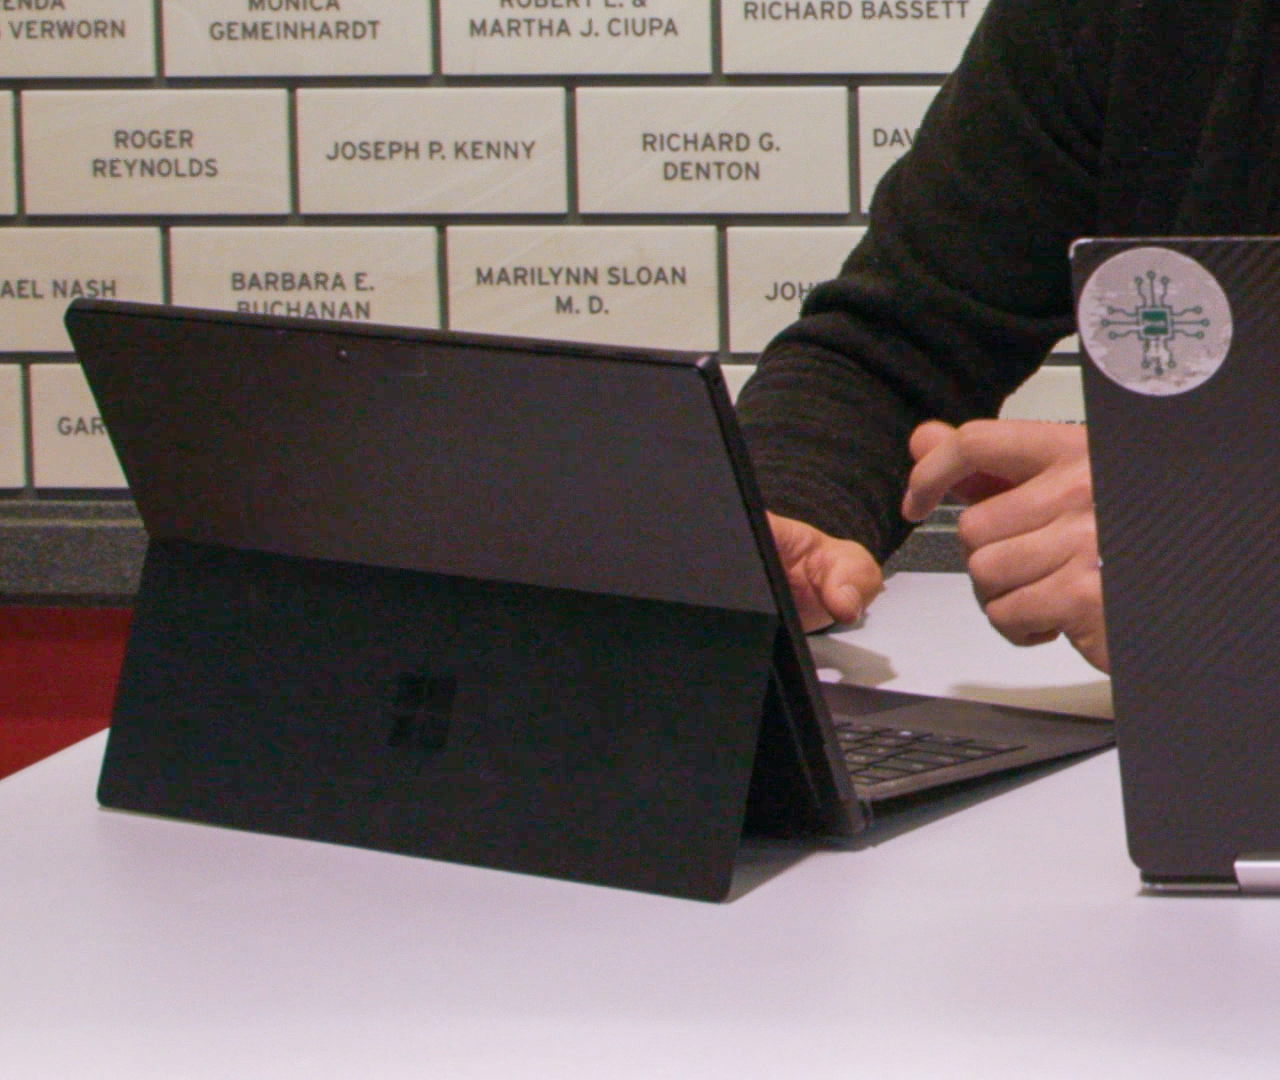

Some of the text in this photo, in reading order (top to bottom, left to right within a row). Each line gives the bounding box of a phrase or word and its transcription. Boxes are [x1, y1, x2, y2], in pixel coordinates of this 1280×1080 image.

[743, 0, 970, 21] RICHARD BASSETT
[7, 19, 126, 40] VERWORN
[208, 19, 380, 41] GEMEINHARDT
[469, 17, 679, 38] MARTHA CIUPA
[113, 129, 194, 150] ROGER
[641, 132, 751, 153] RICHARD
[325, 140, 536, 162] JOSEPH KENNY
[91, 157, 219, 179] REYNOLDS
[663, 160, 761, 182] DENTON
[230, 271, 347, 292] BARBARA
[475, 265, 687, 287] MARILYNN SLOAN
[52, 279, 117, 300] NASH
[555, 295, 580, 315] M.
